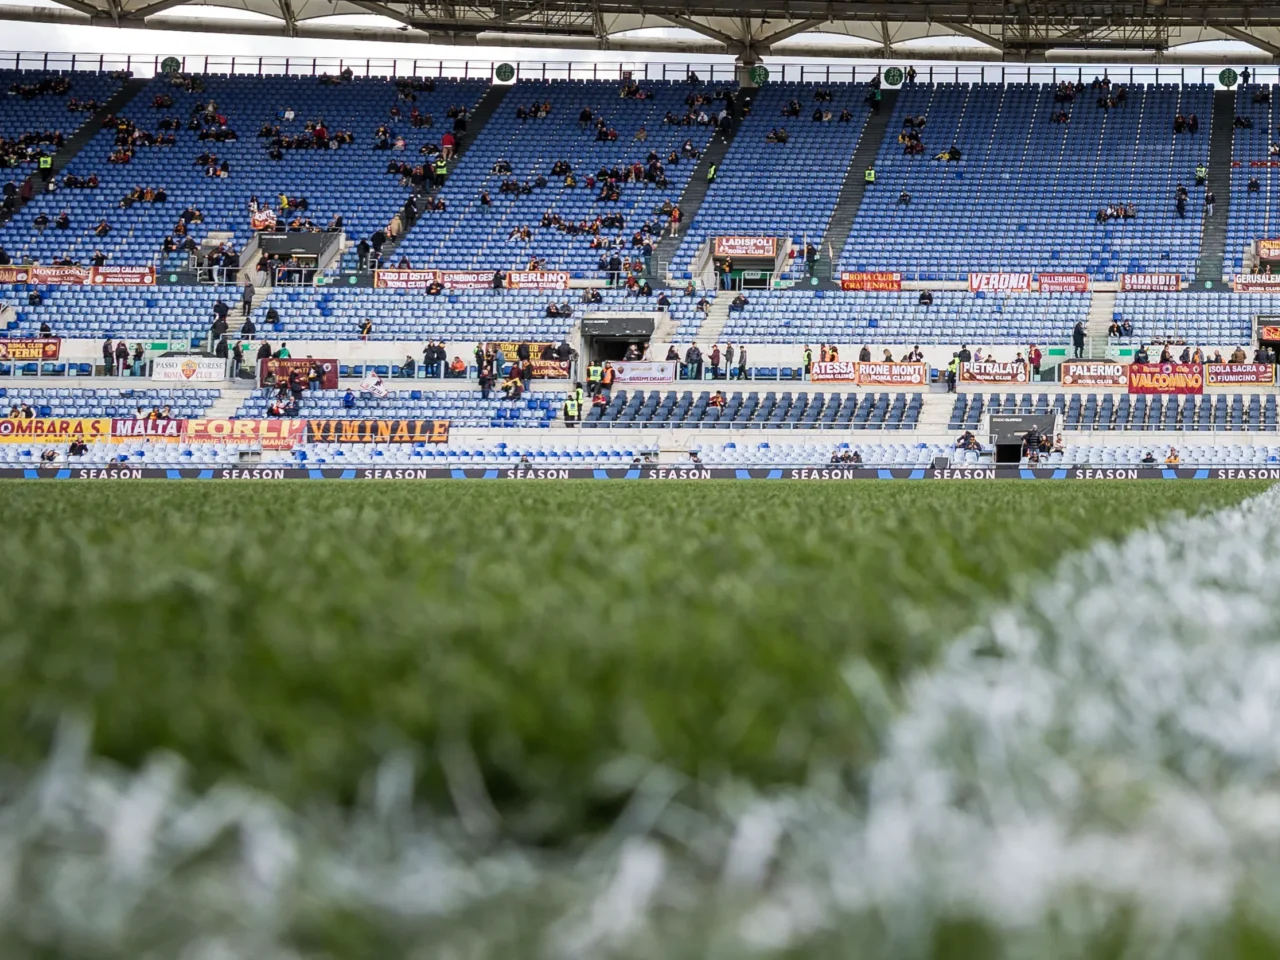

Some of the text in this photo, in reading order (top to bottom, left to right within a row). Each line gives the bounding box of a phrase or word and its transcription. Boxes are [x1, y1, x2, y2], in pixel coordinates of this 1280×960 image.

[511, 273, 566, 282] BERLINO
[972, 274, 1028, 289] VERONA
[1125, 275, 1176, 284] SABAUDIA
[8, 349, 43, 357] TERNI
[813, 363, 854, 373] ATESSA
[860, 365, 923, 374] RIONE MONTI
[964, 362, 1025, 374] PIETRALATA
[1070, 366, 1122, 375] PALERMO
[1131, 373, 1201, 388] VALCOMINO
[116, 421, 177, 436] MALTA
[188, 420, 299, 437] FORLI'
[310, 421, 449, 441] VIMINALE
[81, 470, 141, 479] SEASON
[223, 470, 283, 479] SEASON
[365, 470, 426, 479] SEASON
[507, 470, 568, 479] SEASON
[650, 470, 710, 479] SEASON
[792, 470, 853, 479] SEASON
[934, 470, 995, 479] SEASON
[1076, 470, 1137, 479] SEASON
[1219, 470, 1279, 479] SEASON
